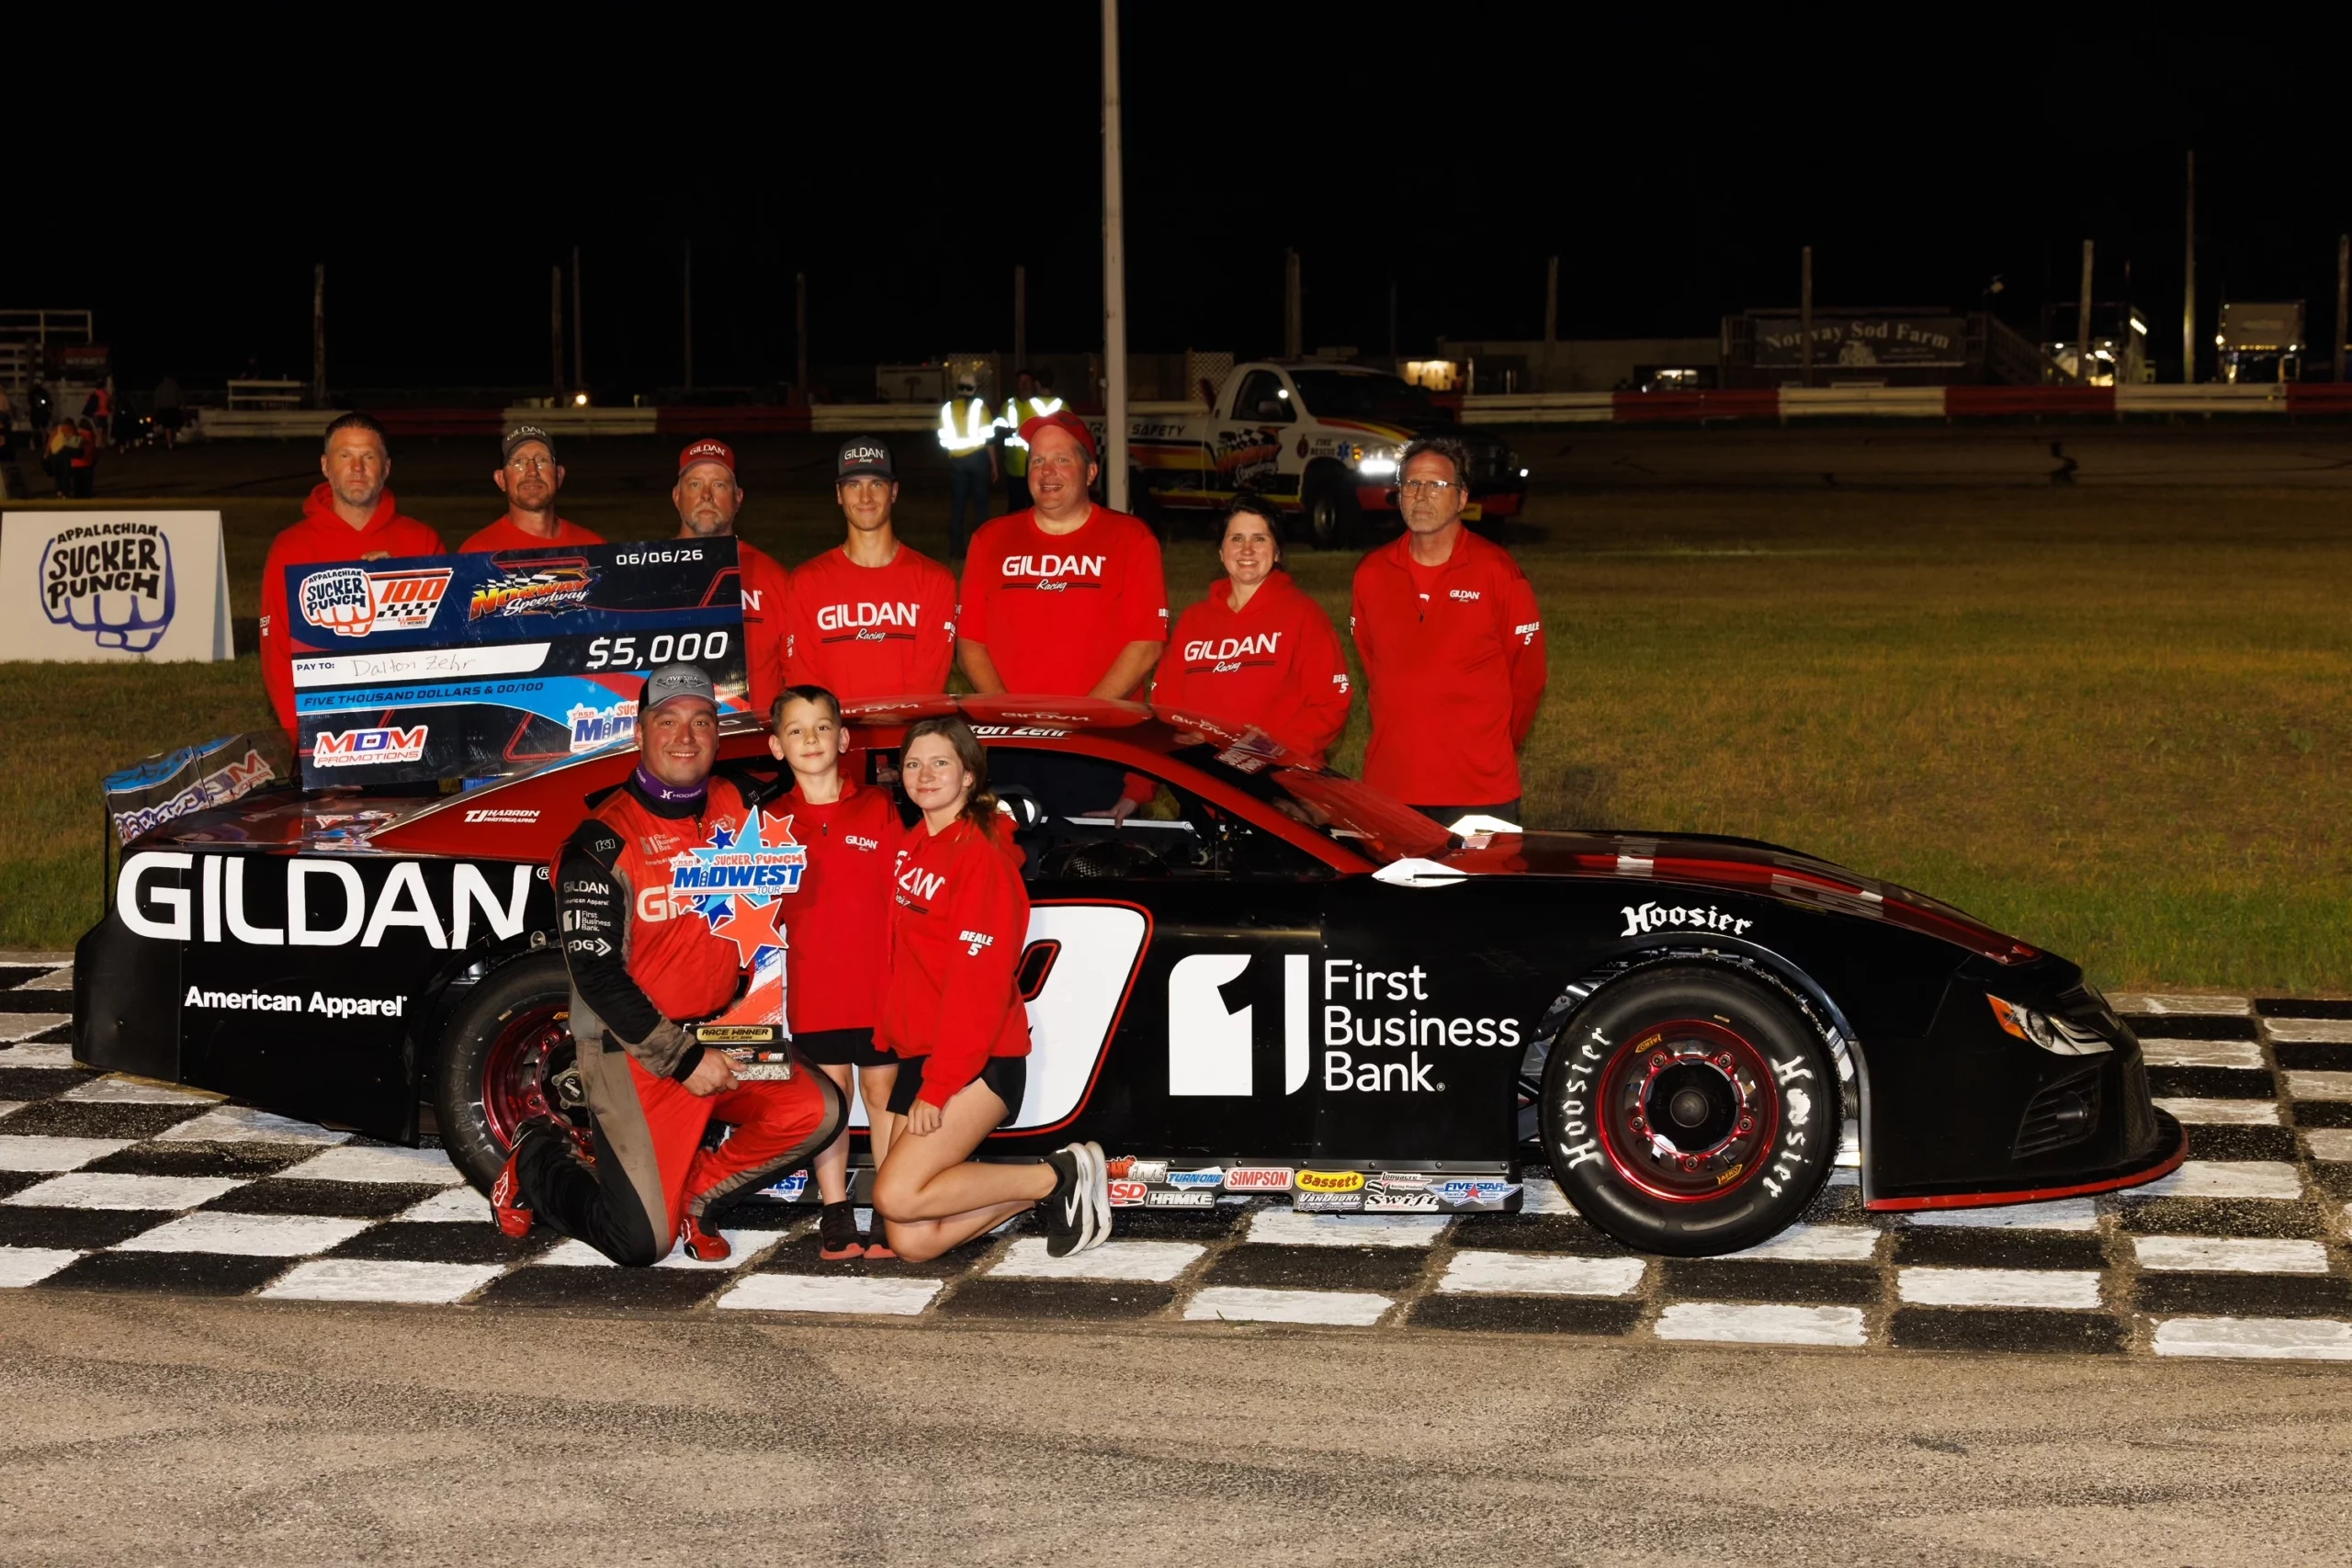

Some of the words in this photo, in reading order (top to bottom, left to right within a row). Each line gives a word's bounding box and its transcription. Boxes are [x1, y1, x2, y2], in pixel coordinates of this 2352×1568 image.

[1851, 321, 1888, 339] Sod
[1896, 323, 1950, 350] Farm
[506, 425, 547, 441] GILDAN
[1131, 423, 1185, 436] SAFETY
[689, 444, 725, 456] GILDAN
[844, 446, 884, 460] GILDAN
[57, 522, 159, 545] APPALACHIAN
[48, 538, 161, 581] SUCKER
[616, 549, 704, 566] 06/06/26
[1001, 554, 1102, 577] GILDAN
[308, 570, 363, 583] APPALACHIAN
[47, 571, 161, 609] PUNCH
[306, 577, 366, 603] SUCKER
[379, 578, 448, 604] 100
[1036, 579, 1068, 592] Racing
[469, 579, 594, 622] NORWAY
[1449, 589, 1480, 600] GILDAN
[306, 594, 367, 616] PUNCH
[503, 591, 590, 617] Speedway
[817, 602, 917, 630] GILDAN
[855, 628, 887, 643] Racing
[1514, 622, 1540, 635] BEALE
[1184, 632, 1278, 661] GILDAN
[1523, 633, 1533, 645] 5
[586, 631, 729, 670] $5,000
[296, 662, 316, 671] PAY
[318, 661, 335, 670] TO:
[350, 659, 416, 677] Dalton
[424, 655, 477, 671] Zehr
[1213, 660, 1242, 673] Racing
[1332, 673, 1349, 683] BEA
[304, 695, 335, 706] FIVE
[337, 691, 414, 705] THOUSAND
[416, 685, 481, 699] DOLLARS
[483, 685, 493, 694] &
[497, 682, 544, 694] 00/100
[1339, 682, 1349, 694] 5
[967, 724, 1010, 735] ton
[318, 728, 424, 753] MDM
[317, 750, 420, 764] PROMOTIONS
[464, 810, 490, 822] TJ
[845, 835, 878, 850] GILDAN
[714, 854, 752, 865] SUCKER
[754, 853, 804, 864] PUNCH
[673, 864, 804, 888] MIDWEST
[564, 880, 609, 895] GILDAN
[757, 886, 781, 894] TOUR
[587, 897, 609, 906] Apparel
[582, 910, 598, 919] First
[1620, 901, 1753, 937] Hoosier
[582, 918, 611, 927] Business
[958, 930, 994, 946] BEALE
[568, 939, 594, 953] FDG
[967, 943, 983, 956] 5
[1325, 959, 1429, 1000] First
[184, 986, 302, 1012] American
[307, 991, 404, 1019] Apparel
[1325, 1004, 1521, 1048] Business
[1560, 1025, 1612, 1171] Hoosier
[1168, 1173, 1200, 1183] TURN
[1199, 1173, 1224, 1183] ONE
[1230, 1171, 1288, 1186] SIMPSON
[1301, 1174, 1358, 1188] Bassett
[1382, 1172, 1419, 1180] Longacre
[1108, 1183, 1147, 1199] SD
[1444, 1182, 1471, 1191] FIVE
[1478, 1182, 1504, 1191] STAR
[1149, 1193, 1214, 1205] HAMKE
[1365, 1194, 1437, 1206] Swift
